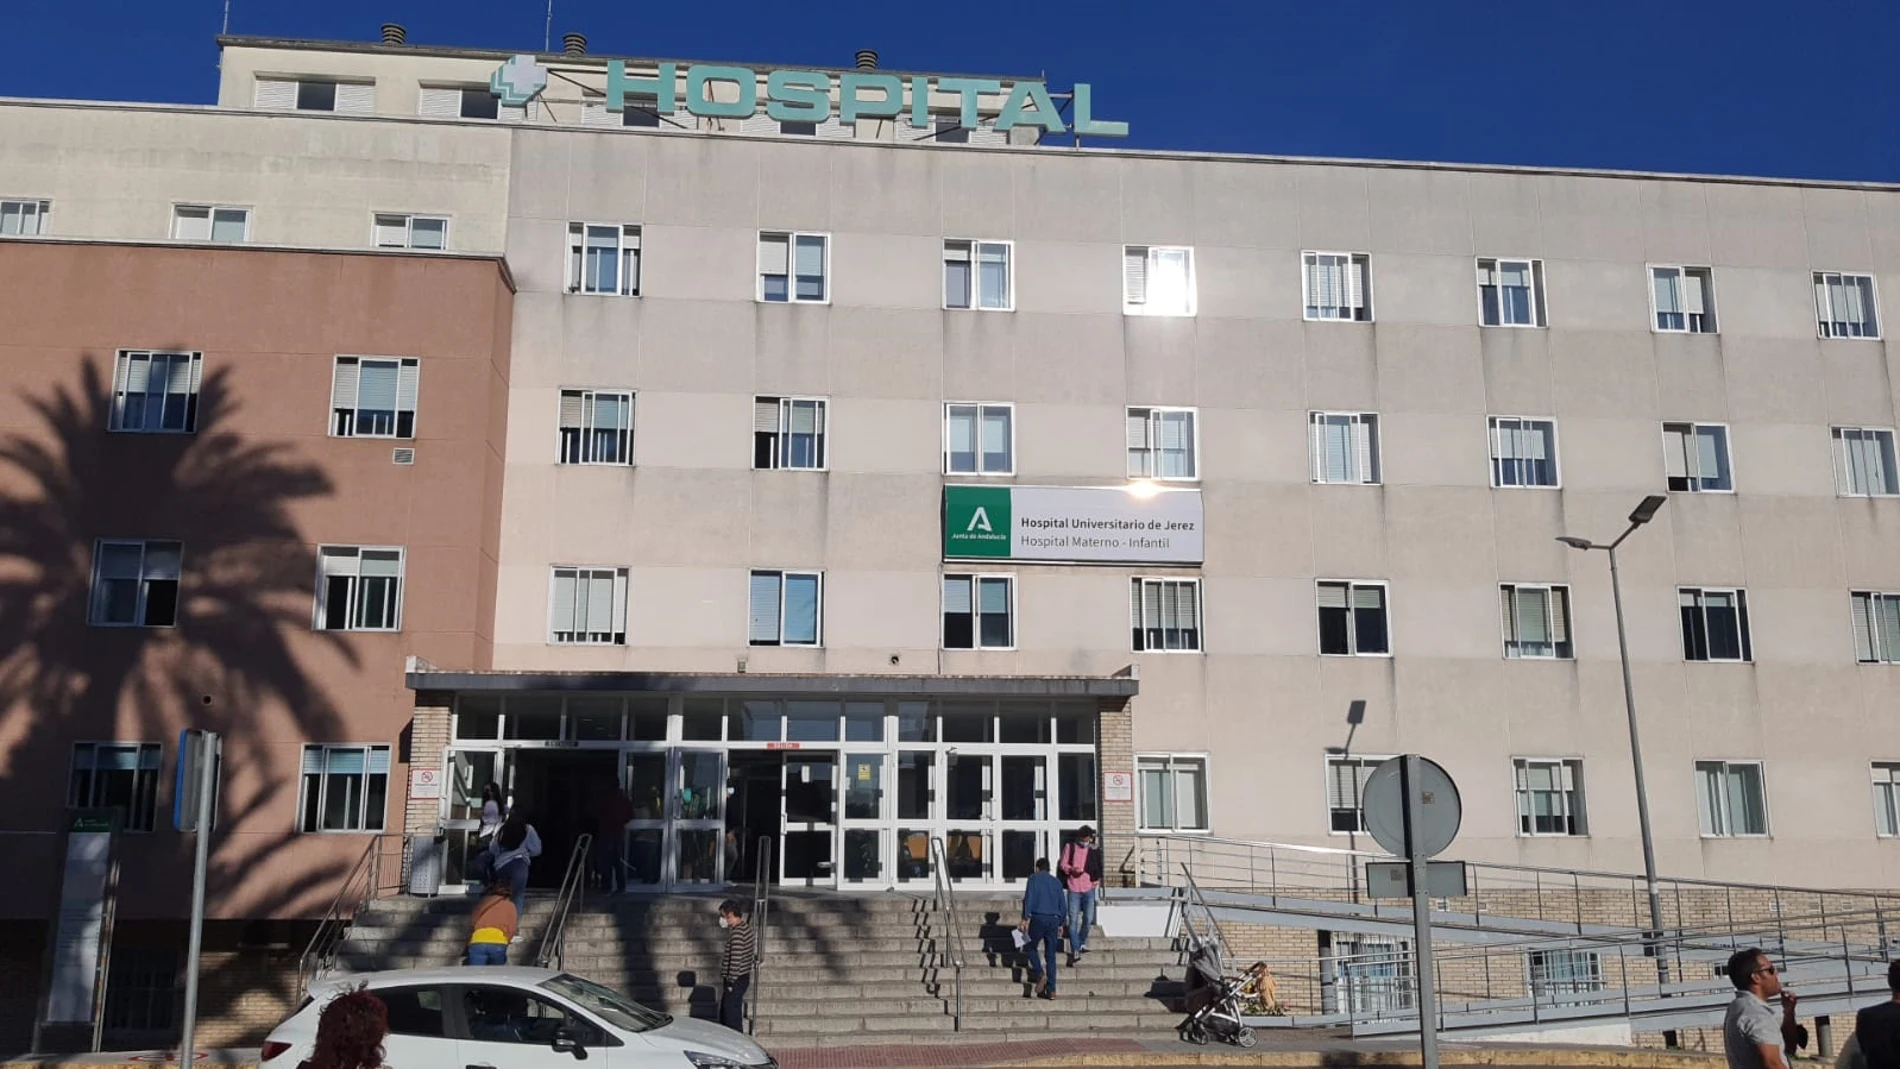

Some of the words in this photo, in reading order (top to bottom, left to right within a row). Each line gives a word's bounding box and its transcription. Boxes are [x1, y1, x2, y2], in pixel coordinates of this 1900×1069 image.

[606, 60, 1129, 136] HOSPITAL
[1021, 518, 1069, 529] Hospital
[1071, 519, 1145, 530] Universitario
[1148, 520, 1161, 530] de
[1164, 521, 1195, 530] Jerez
[1021, 536, 1069, 548] Hospital
[1072, 536, 1119, 548] Materno
[1129, 537, 1170, 548] Infantil
